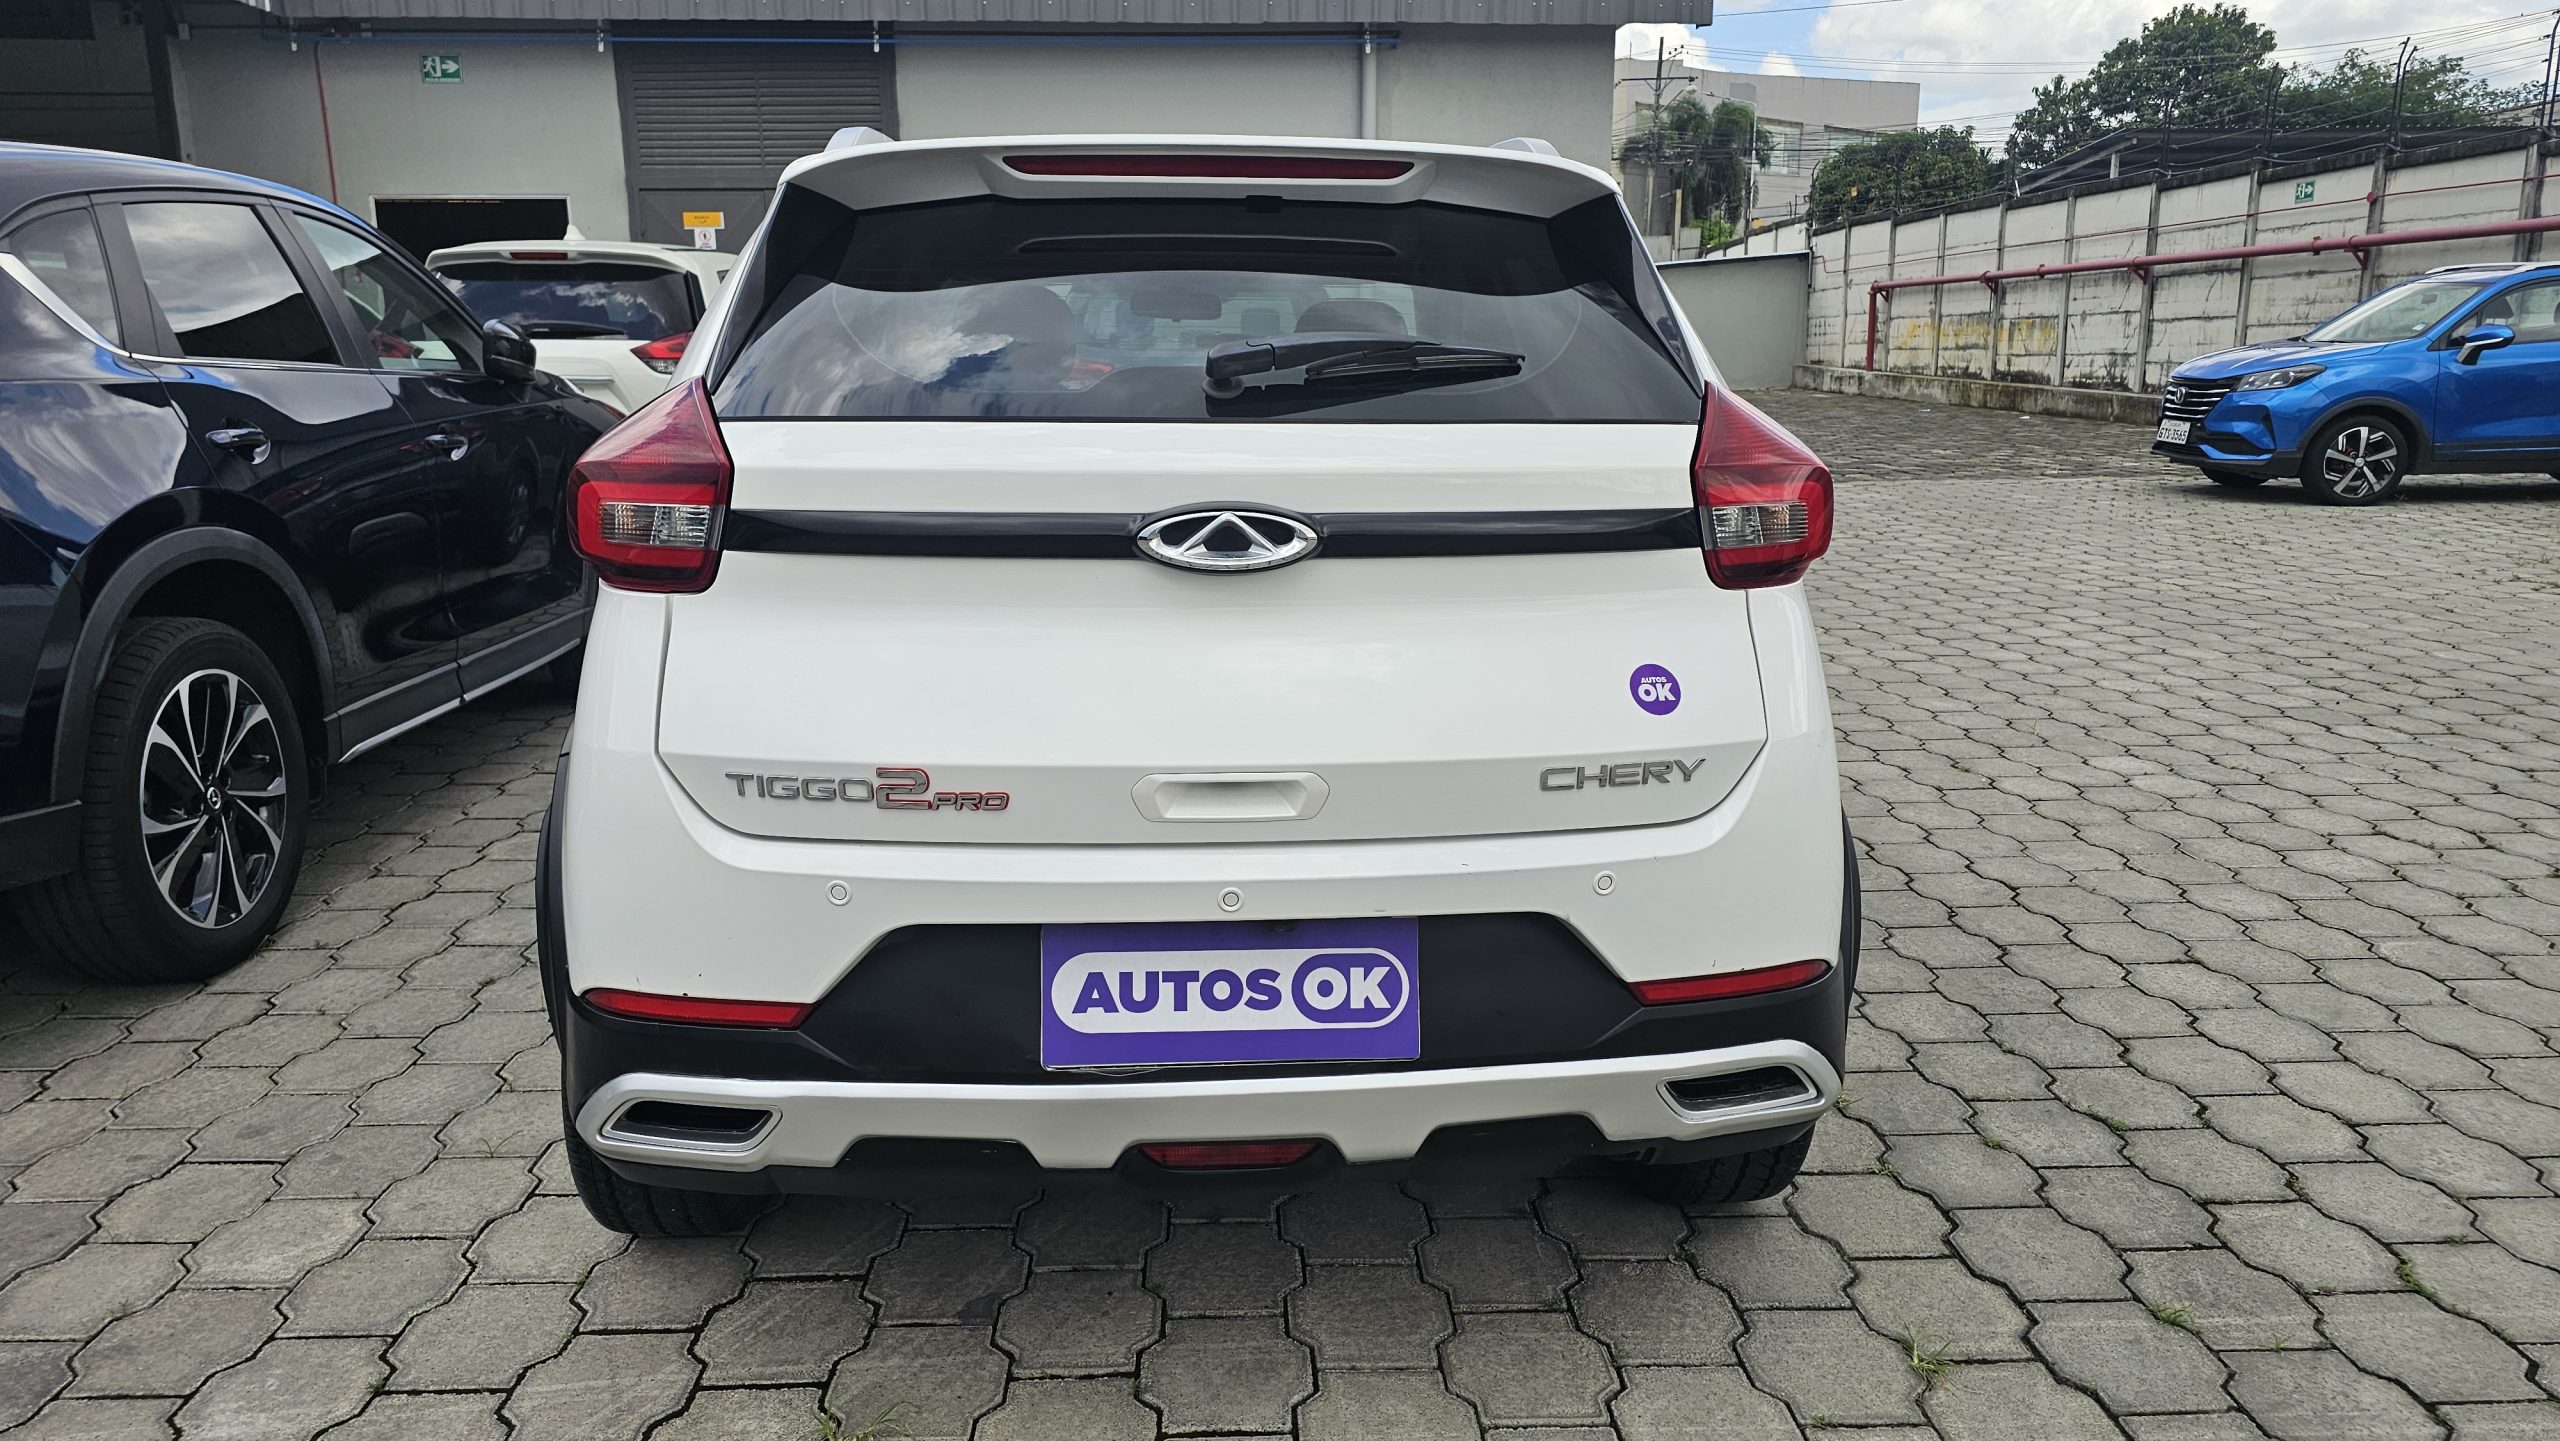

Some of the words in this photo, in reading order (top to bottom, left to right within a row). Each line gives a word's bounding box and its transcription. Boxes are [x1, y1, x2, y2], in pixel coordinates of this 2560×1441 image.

[1638, 683, 1676, 701] OK
[1539, 757, 1707, 792] CHERY
[1071, 968, 1283, 1015] AUTOS
[1302, 966, 1392, 1011] OK
